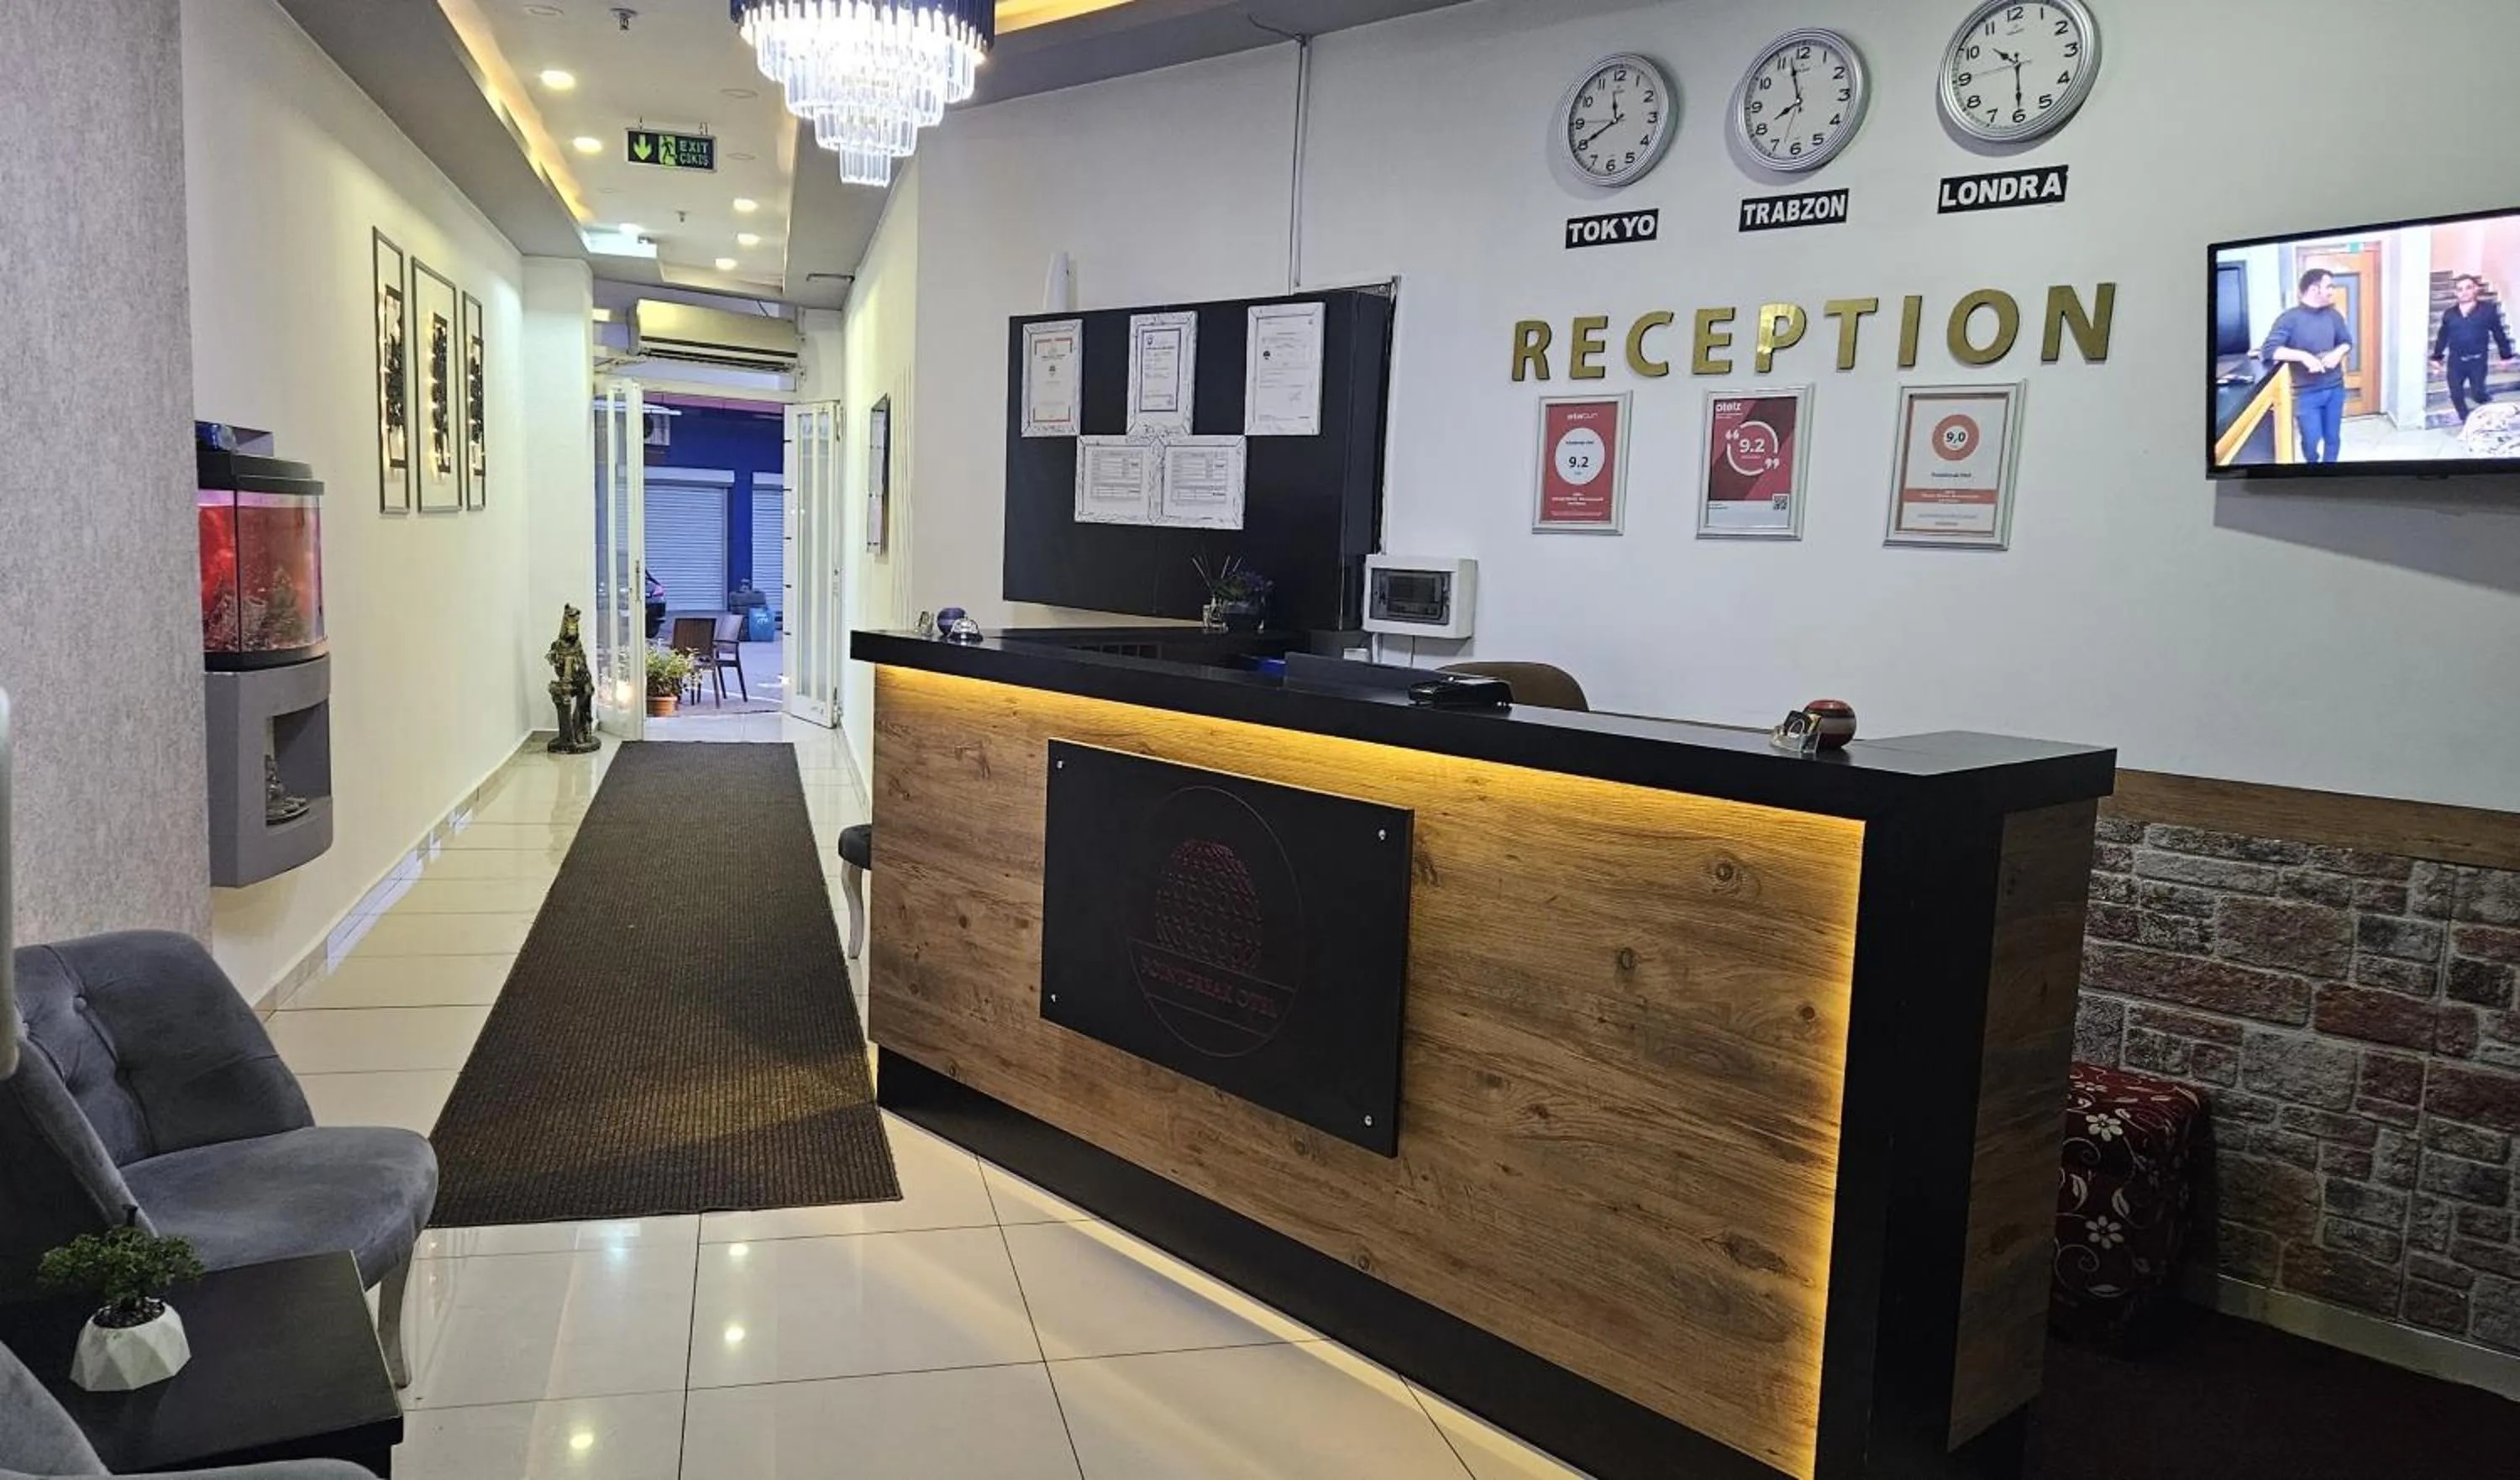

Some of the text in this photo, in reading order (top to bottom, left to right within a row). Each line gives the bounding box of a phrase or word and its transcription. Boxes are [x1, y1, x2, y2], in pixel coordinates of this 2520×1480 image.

[2007, 7, 2024, 23] 12
[1985, 21, 1995, 36] 11
[2055, 20, 2068, 35] 2
[1796, 47, 1810, 59] 12
[1966, 45, 1980, 60] 10
[2063, 42, 2078, 57] 3
[1777, 56, 1787, 71] 11
[1614, 71, 1626, 81] 12
[1833, 66, 1845, 79] 2
[1958, 72, 1971, 86] 9
[2056, 71, 2070, 84] 4
[1598, 79, 1606, 91] 11
[1759, 77, 1772, 90] 10
[1643, 91, 1654, 102] 2
[1837, 88, 1851, 101] 3
[2039, 94, 2052, 108] 5
[1583, 96, 1593, 108] 10
[1751, 102, 1762, 113] 9
[1966, 95, 1982, 108] 8
[1647, 112, 1657, 123] 3
[1829, 113, 1840, 125] 4
[1987, 108, 1998, 123] 7
[2012, 109, 2025, 123] 6
[1576, 118, 1585, 129] 9
[1755, 123, 1767, 135] 8
[1578, 139, 1588, 150] 8
[1640, 134, 1649, 145] 4
[1770, 139, 1780, 152] 7
[1812, 133, 1824, 145] 5
[680, 140, 709, 153] EXIT
[1790, 142, 1801, 155] 6
[1590, 155, 1599, 165] 7
[1625, 152, 1635, 164] 5
[1605, 160, 1615, 171] 6
[1941, 172, 2062, 207] LONDRA
[1744, 194, 1845, 226] TRABZON
[1569, 214, 1656, 244] TOKYO
[1512, 282, 2117, 381] RECEPTION
[1740, 438, 1765, 453] 9.2
[1568, 456, 1589, 468] 9.2
